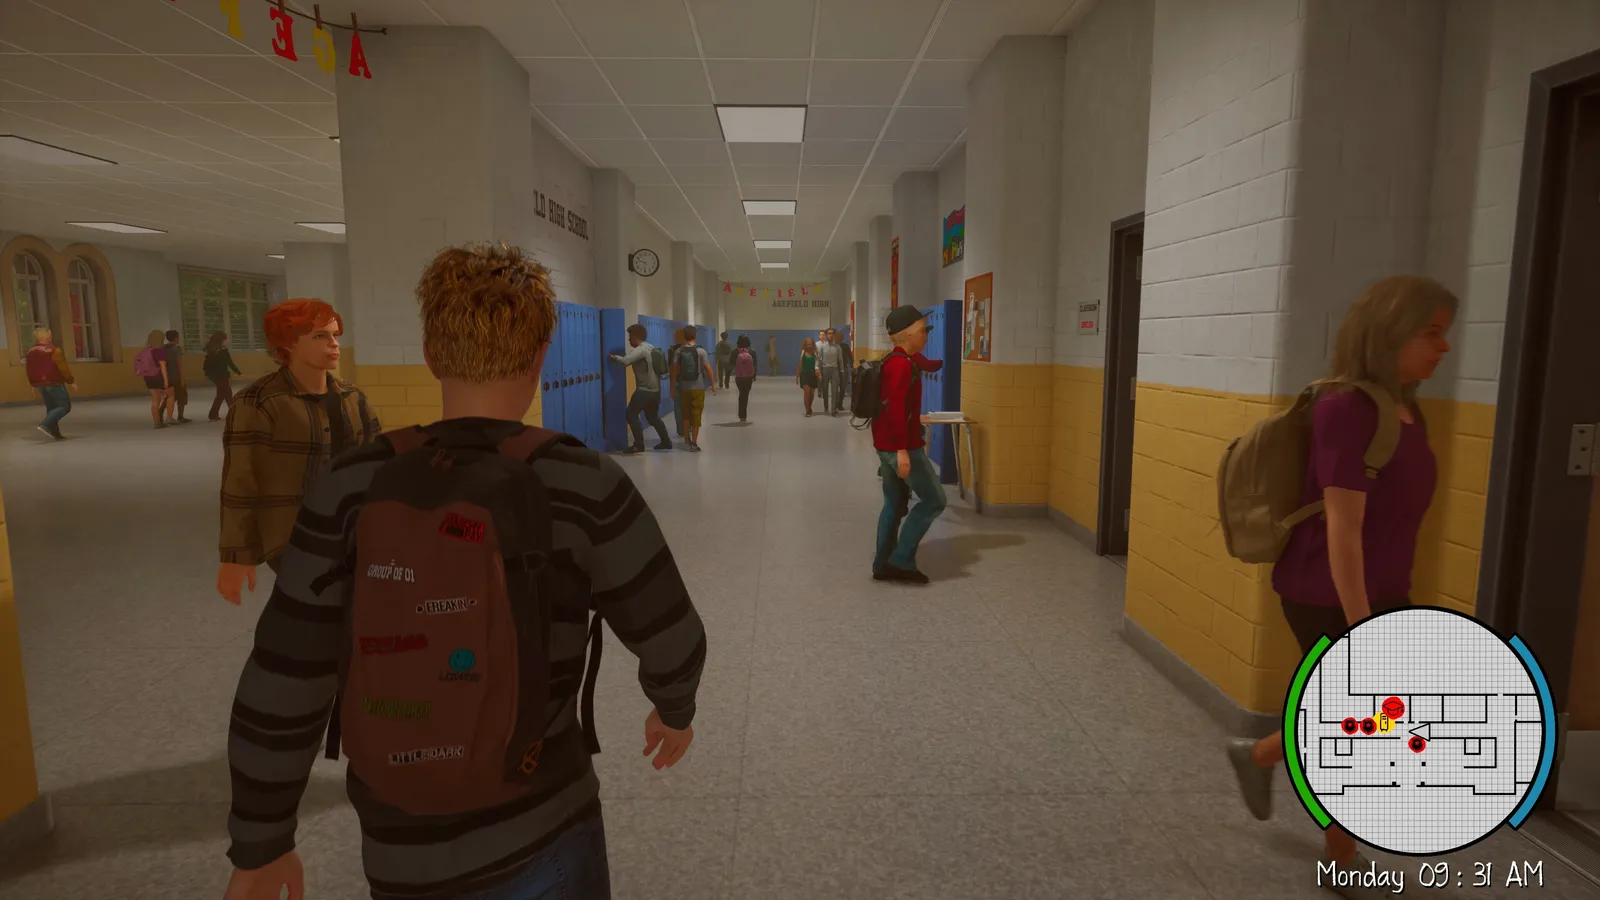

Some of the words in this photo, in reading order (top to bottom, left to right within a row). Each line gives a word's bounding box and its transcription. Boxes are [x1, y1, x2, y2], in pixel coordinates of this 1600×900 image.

[548, 198, 566, 229] HIGH
[811, 300, 829, 308] HIGH
[367, 563, 393, 580] GROUP
[393, 566, 404, 581] OF
